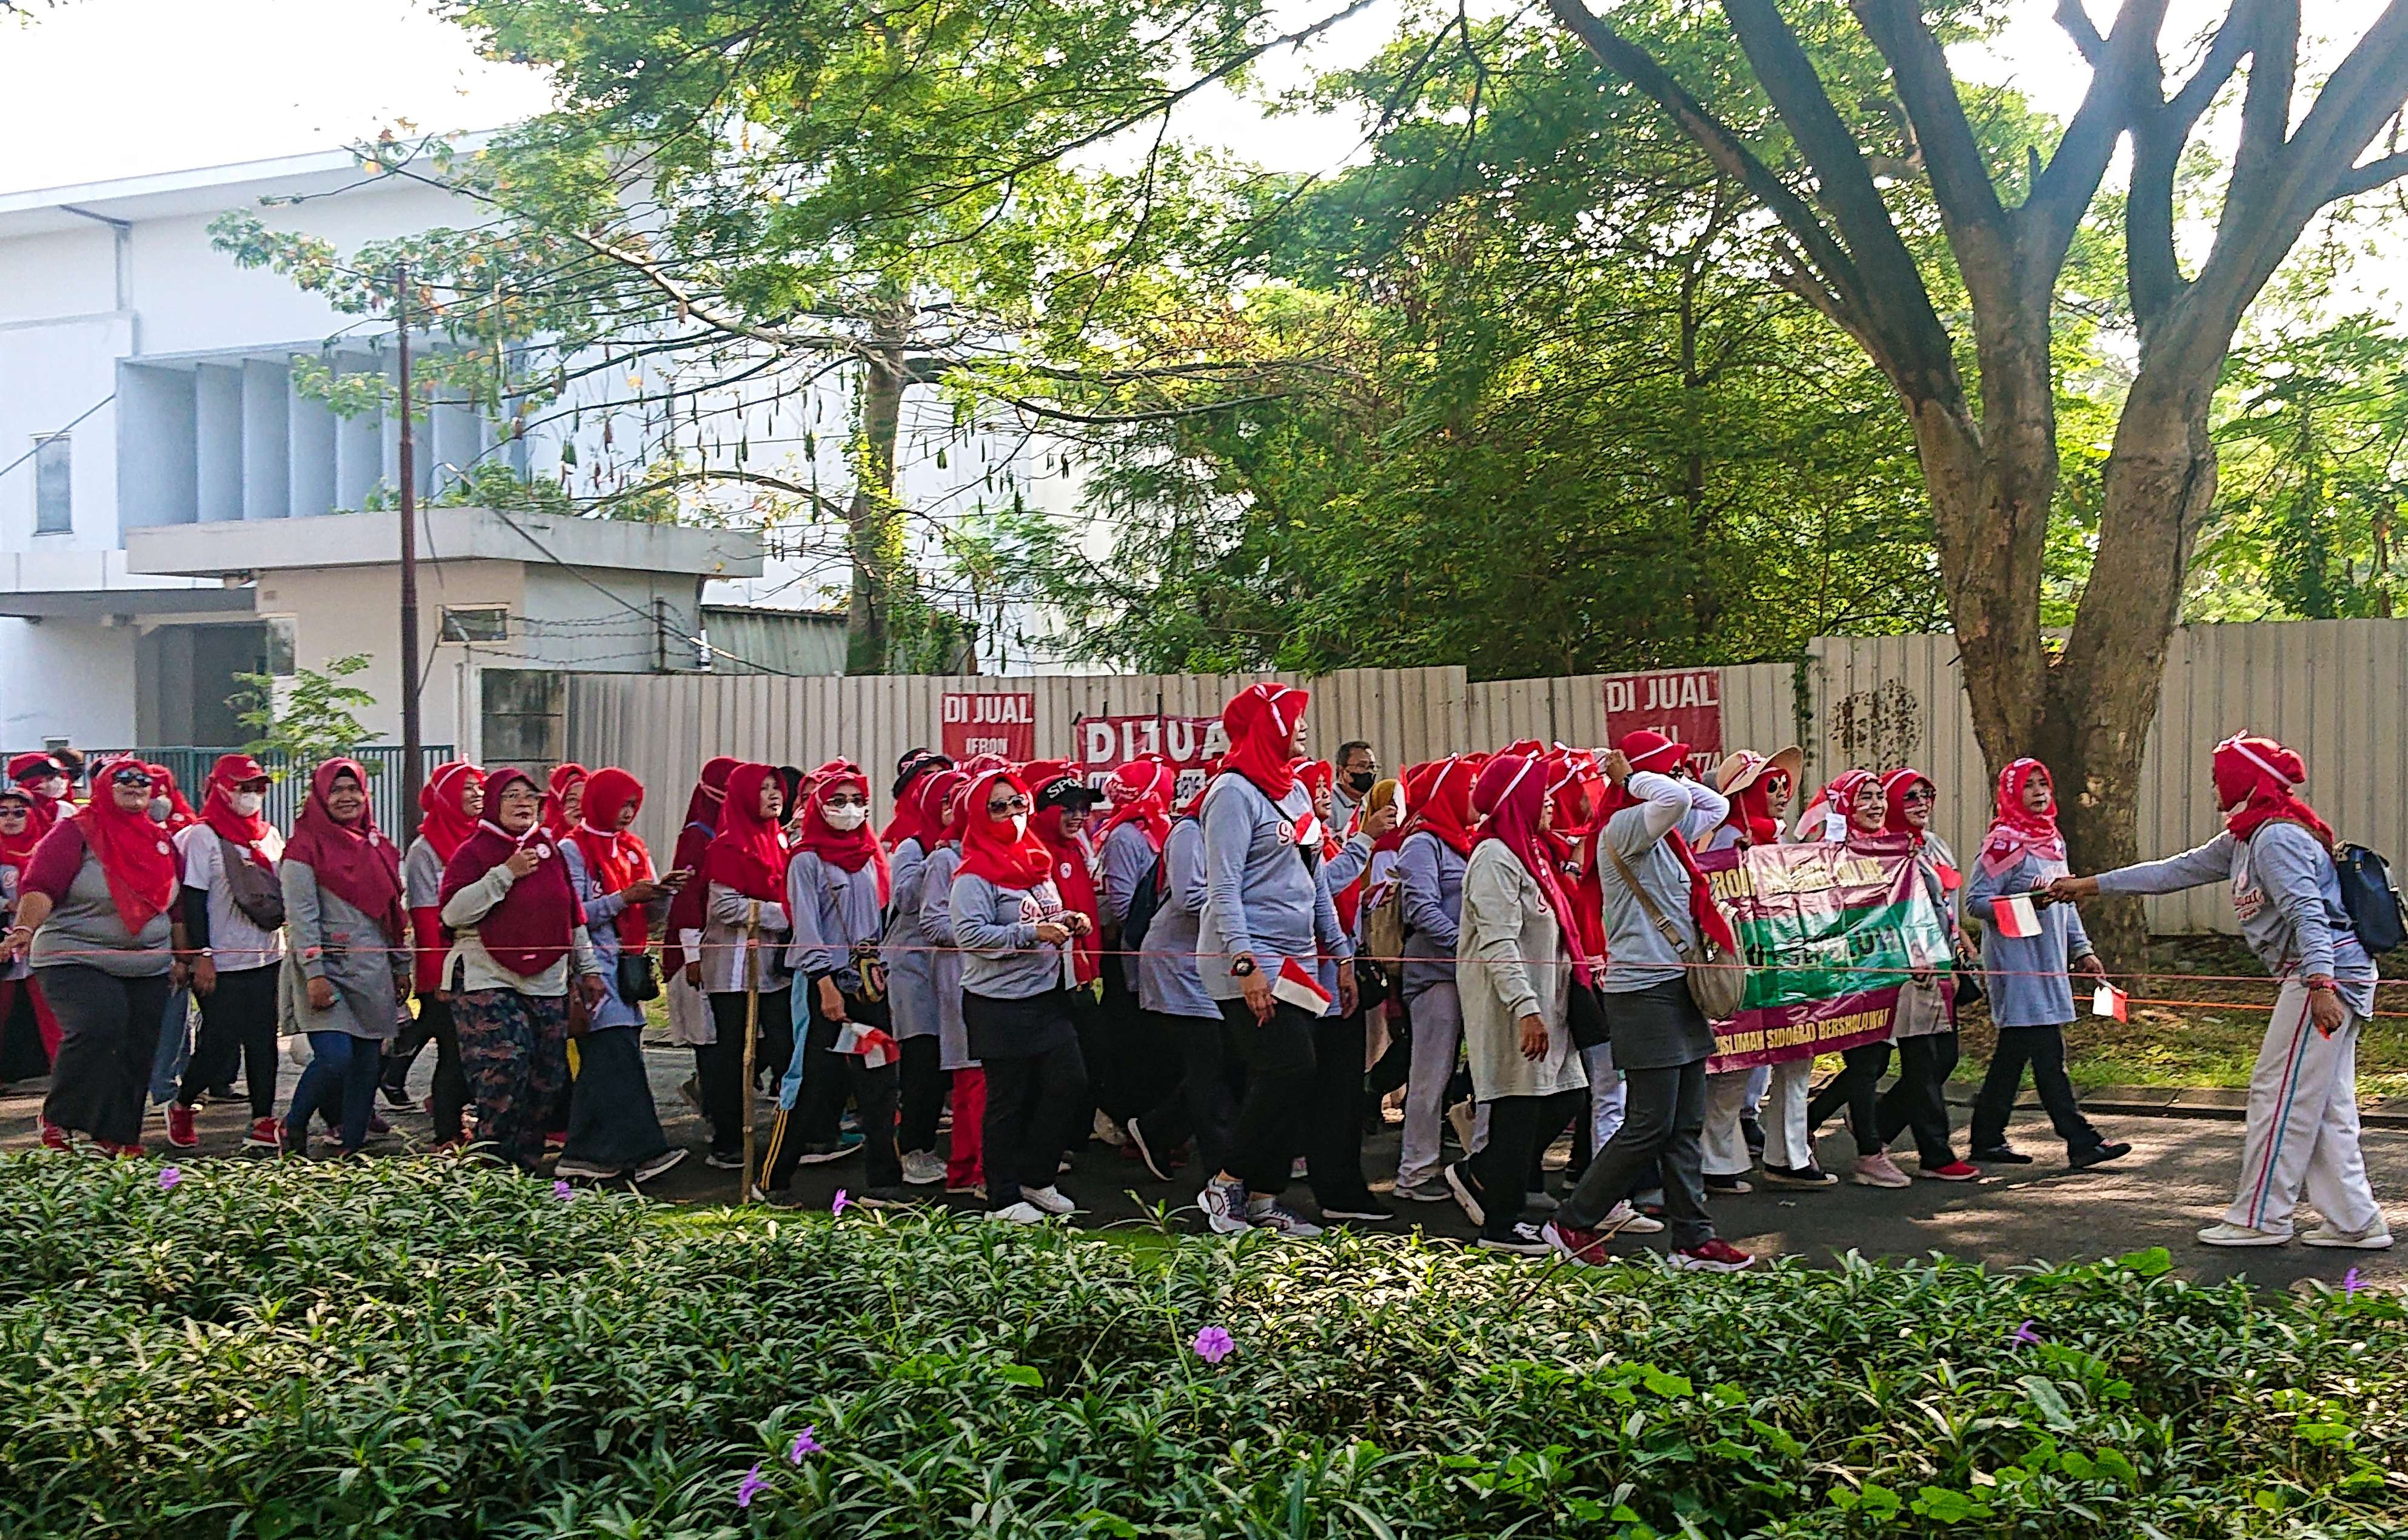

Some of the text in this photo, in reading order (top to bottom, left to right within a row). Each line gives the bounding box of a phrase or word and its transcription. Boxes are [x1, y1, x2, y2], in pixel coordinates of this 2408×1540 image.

[945, 696, 1034, 724] DI JUAL
[1607, 675, 1718, 712] DI JUAL
[1702, 868, 1757, 901] ROUP
